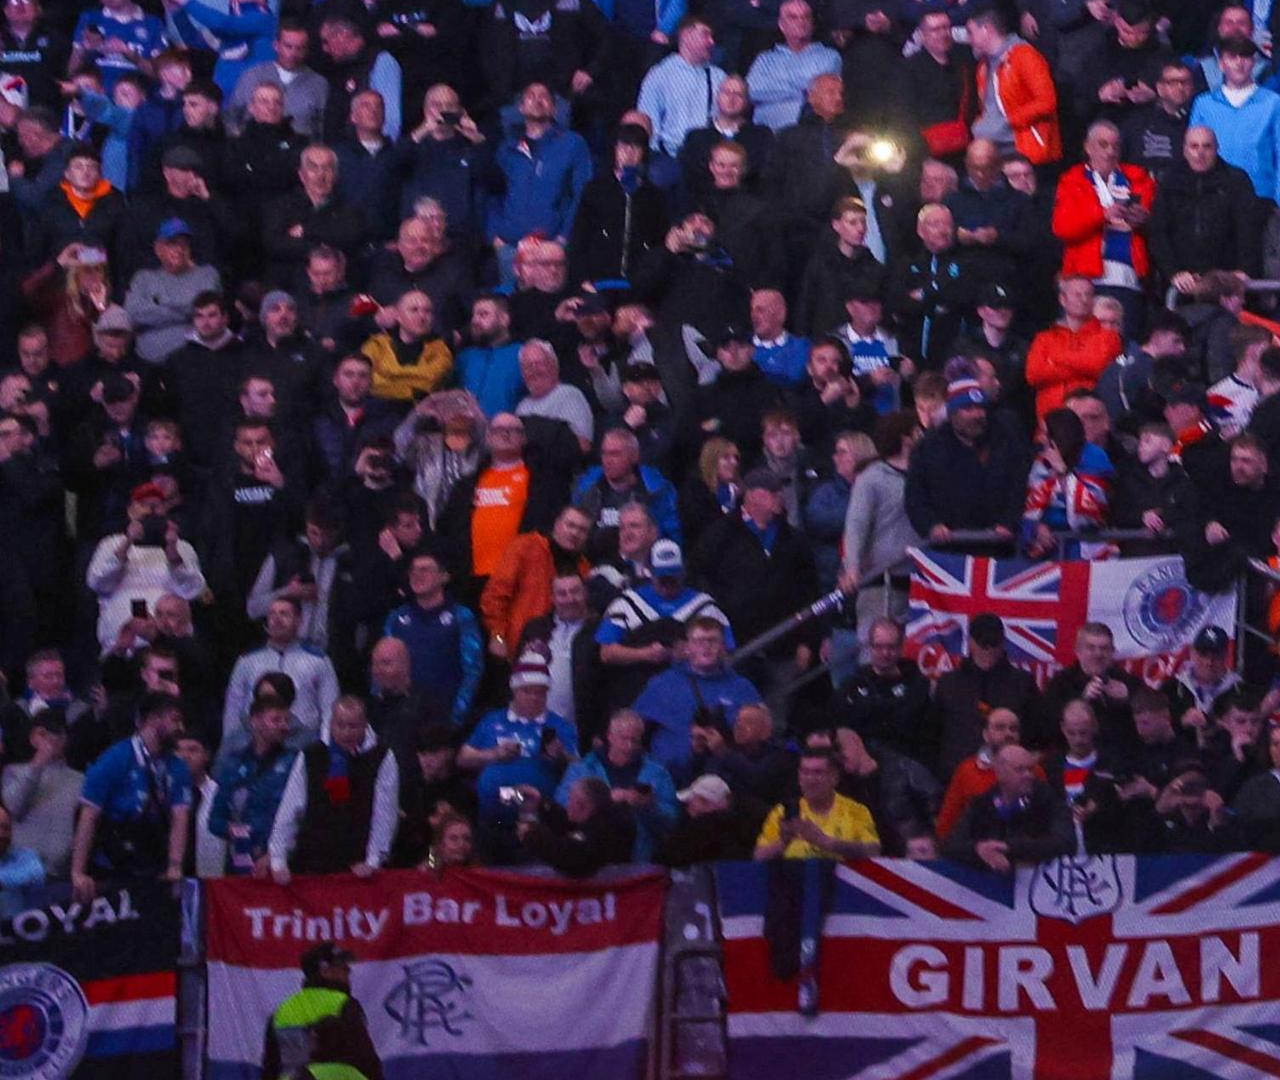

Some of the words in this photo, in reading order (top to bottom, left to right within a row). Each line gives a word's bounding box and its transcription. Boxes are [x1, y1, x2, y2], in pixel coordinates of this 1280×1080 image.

[245, 906, 389, 941] Trinity
[403, 892, 480, 925] Bar
[495, 894, 617, 935] Loyal
[888, 932, 1261, 1011] GIRVAN
